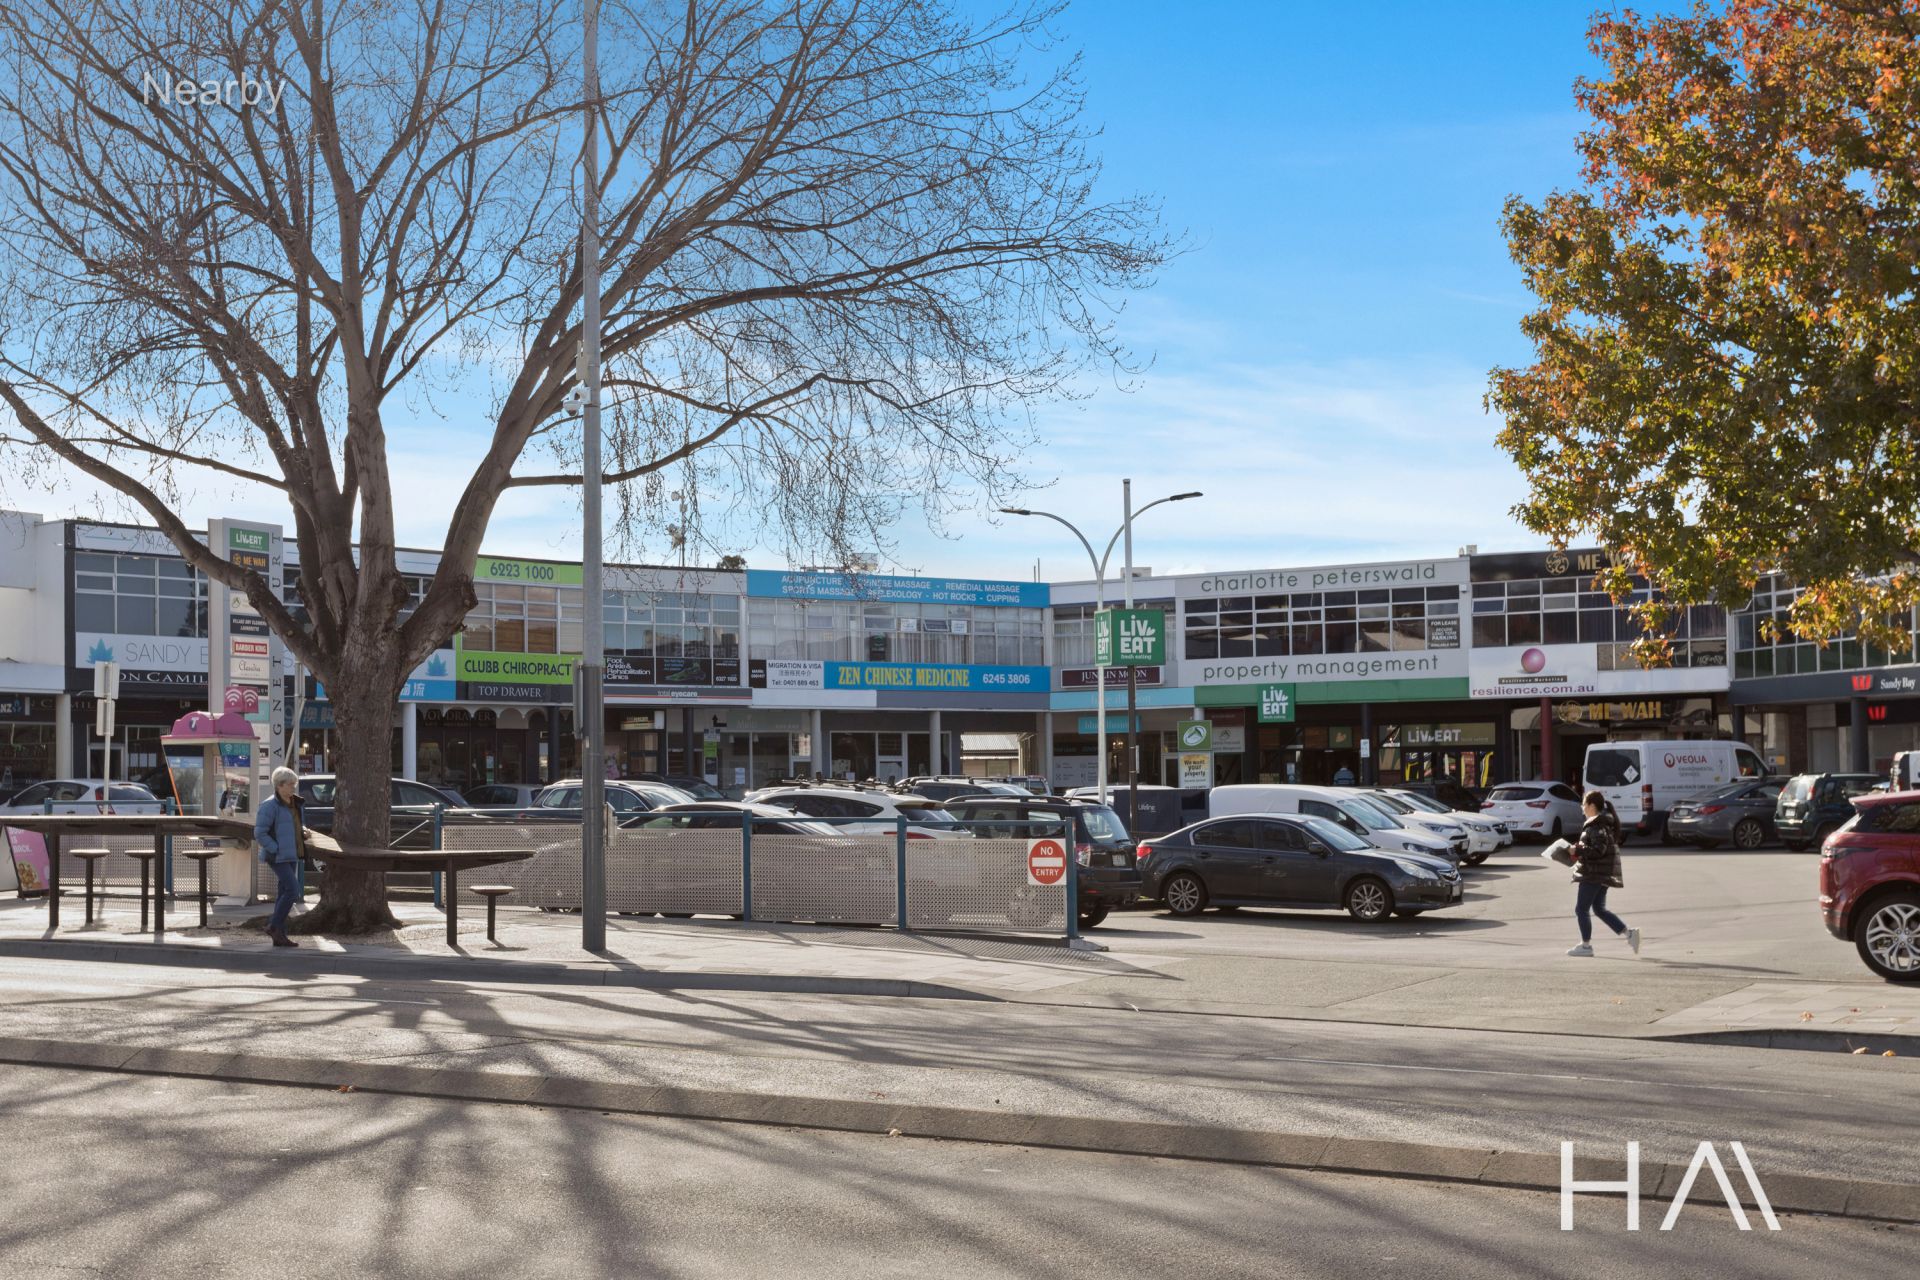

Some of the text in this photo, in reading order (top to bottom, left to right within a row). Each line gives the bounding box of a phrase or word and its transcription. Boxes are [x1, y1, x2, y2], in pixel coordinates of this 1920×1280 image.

[1577, 554, 1601, 571] ME
[490, 562, 554, 580] 6223 1000
[1200, 564, 1436, 592] charlotte peterswald
[782, 585, 815, 595] SPORTS
[817, 587, 856, 596] MASSAGE
[932, 592, 948, 600] HOT
[950, 592, 977, 602] ROCKS
[986, 594, 1020, 603] CUPPING
[893, 581, 930, 589] MASSAGE
[945, 582, 983, 592] REMEDIAL
[984, 585, 1020, 593] MASSAGE
[1120, 637, 1156, 654] EAT
[126, 643, 191, 664] SANDY
[464, 659, 572, 676] CLUBB CHIROPRACT
[1118, 669, 1147, 679] MON
[1203, 654, 1439, 681] property management
[147, 670, 209, 684] CAMIL
[838, 666, 1030, 687] ZEN CHINESE MEDICINE 6245 3806
[1880, 677, 1916, 690] Sandy Bay
[478, 685, 542, 697] TOP DRAWER
[1472, 684, 1595, 697] resilience.com.au
[1263, 702, 1288, 715] EAT
[1621, 701, 1662, 719] WAH
[1675, 755, 1707, 764] VEOLIA
[1040, 846, 1054, 856] NO
[1035, 868, 1060, 877] ENTRY
